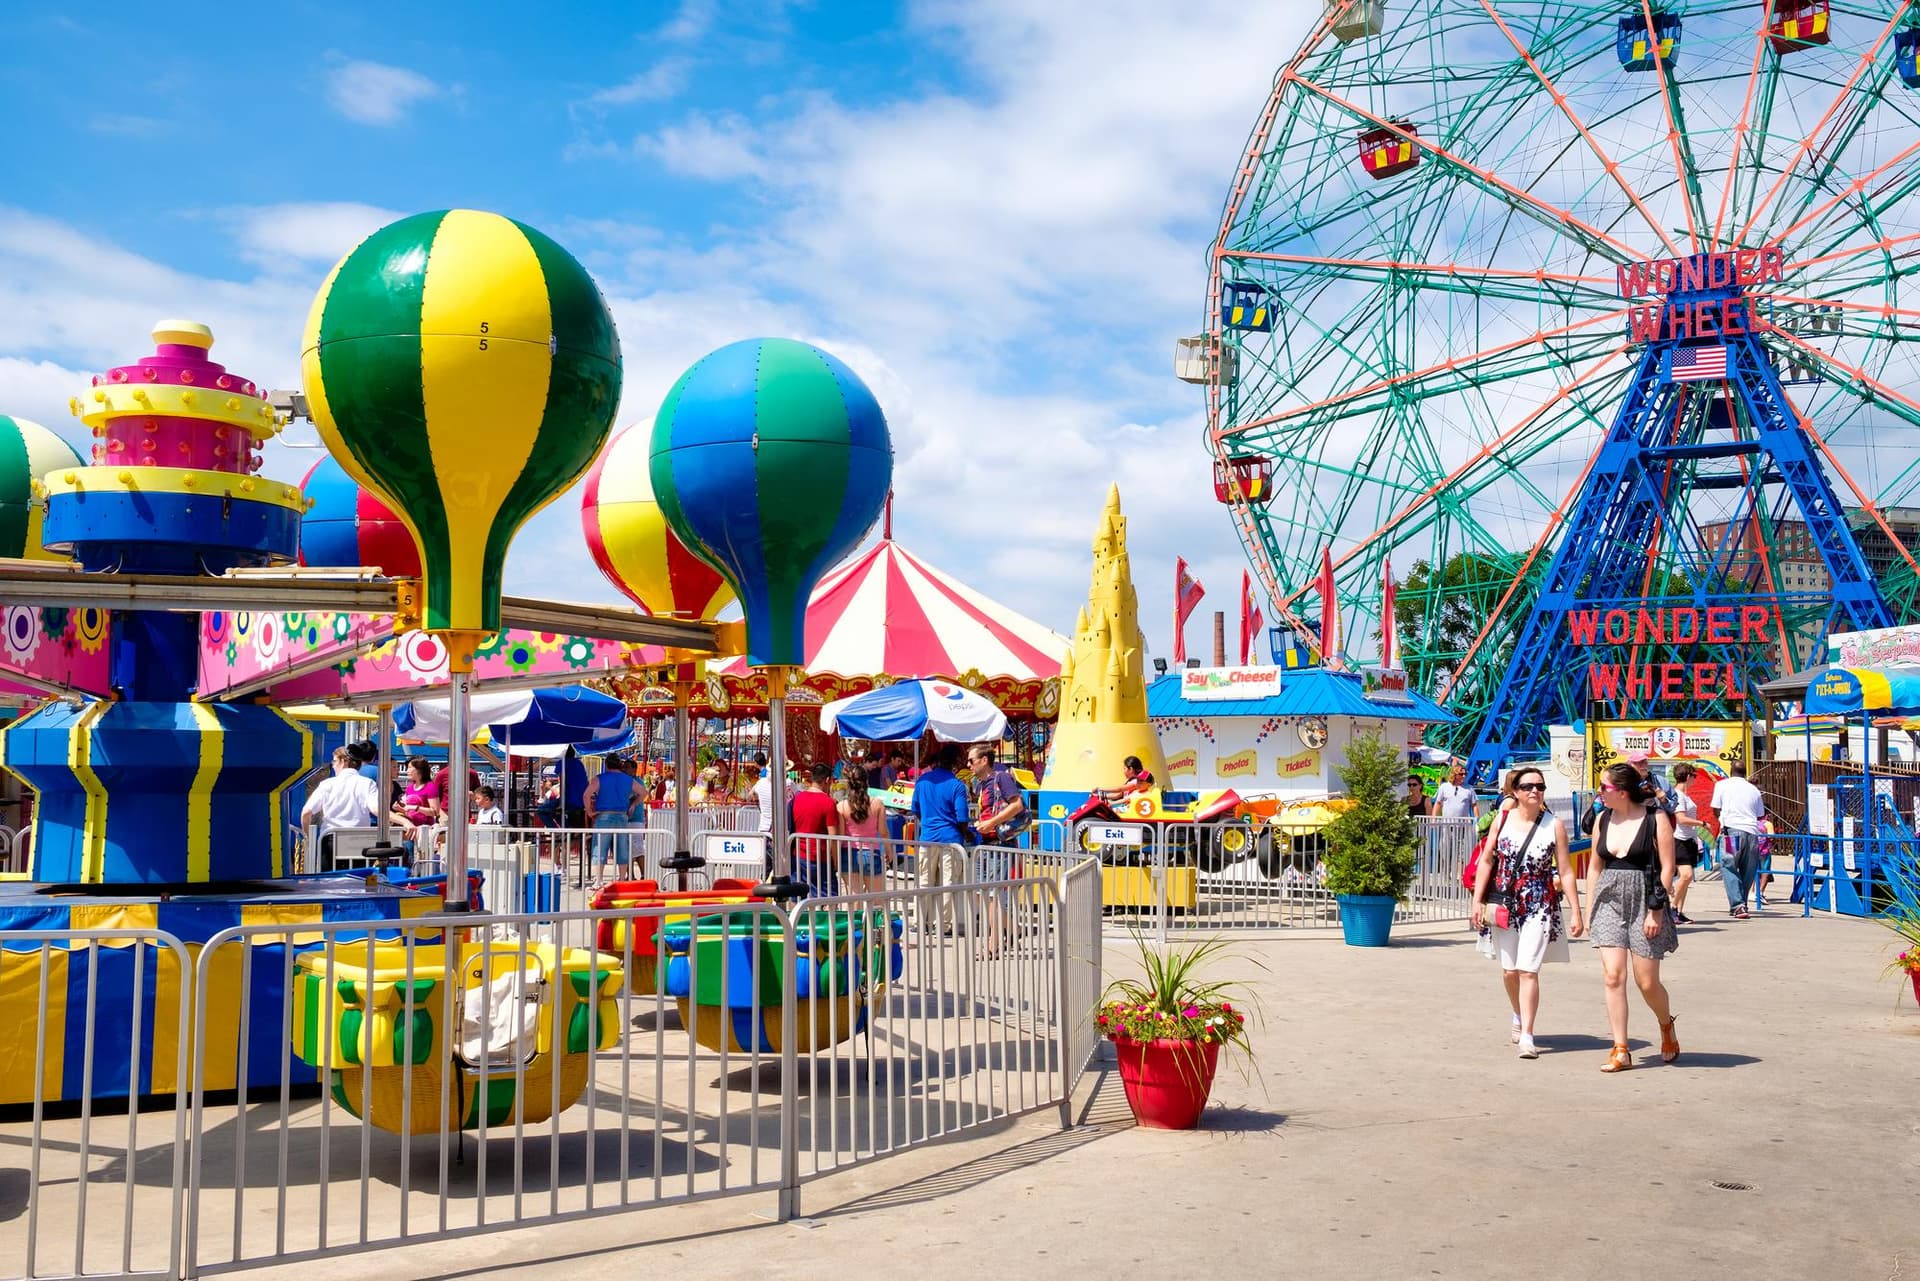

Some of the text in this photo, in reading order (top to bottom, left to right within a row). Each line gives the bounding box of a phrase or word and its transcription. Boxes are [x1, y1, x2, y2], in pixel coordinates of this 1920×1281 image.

[1617, 247, 1783, 299] WONDER
[480, 322, 489, 333] 5
[1629, 298, 1772, 342] WHEEL
[479, 339, 488, 351] 5
[404, 595, 412, 606] 5
[1568, 605, 1770, 646] WONDER
[1186, 670, 1277, 687] Say Cheese!
[1381, 673, 1405, 690] Smile!
[1589, 662, 1747, 700] WHEEL
[461, 682, 468, 693] 5
[1625, 737, 1710, 750] MORE RIDES
[1223, 757, 1249, 772] Photos
[1285, 757, 1312, 772] Tickets
[1140, 800, 1151, 815] 3
[1105, 829, 1125, 839] Exit
[724, 841, 745, 853] Exit
